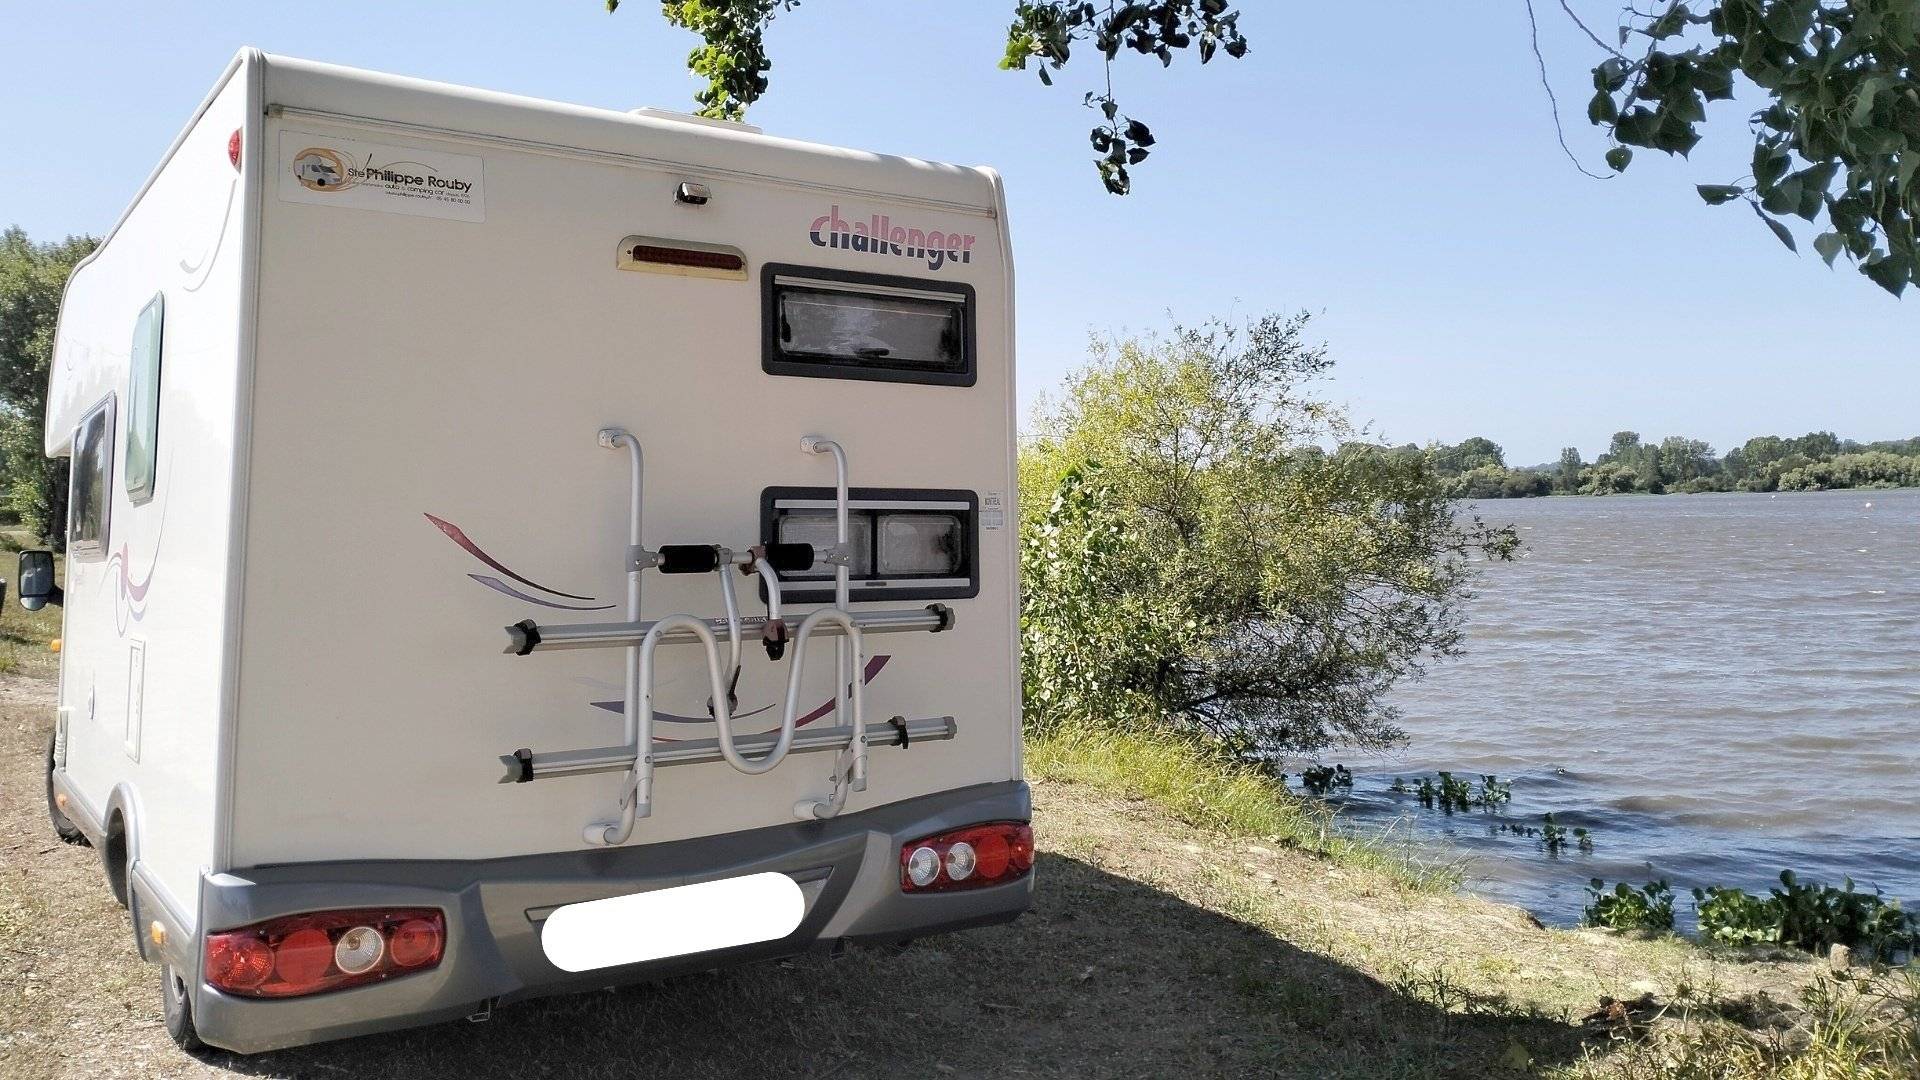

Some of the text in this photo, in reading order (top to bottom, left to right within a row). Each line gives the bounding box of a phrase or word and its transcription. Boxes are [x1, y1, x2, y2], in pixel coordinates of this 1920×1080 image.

[366, 167, 425, 186] Philippe
[427, 175, 472, 193] Rouby
[384, 183, 400, 191] auto
[406, 186, 434, 195] camping
[809, 204, 976, 271] challenger
